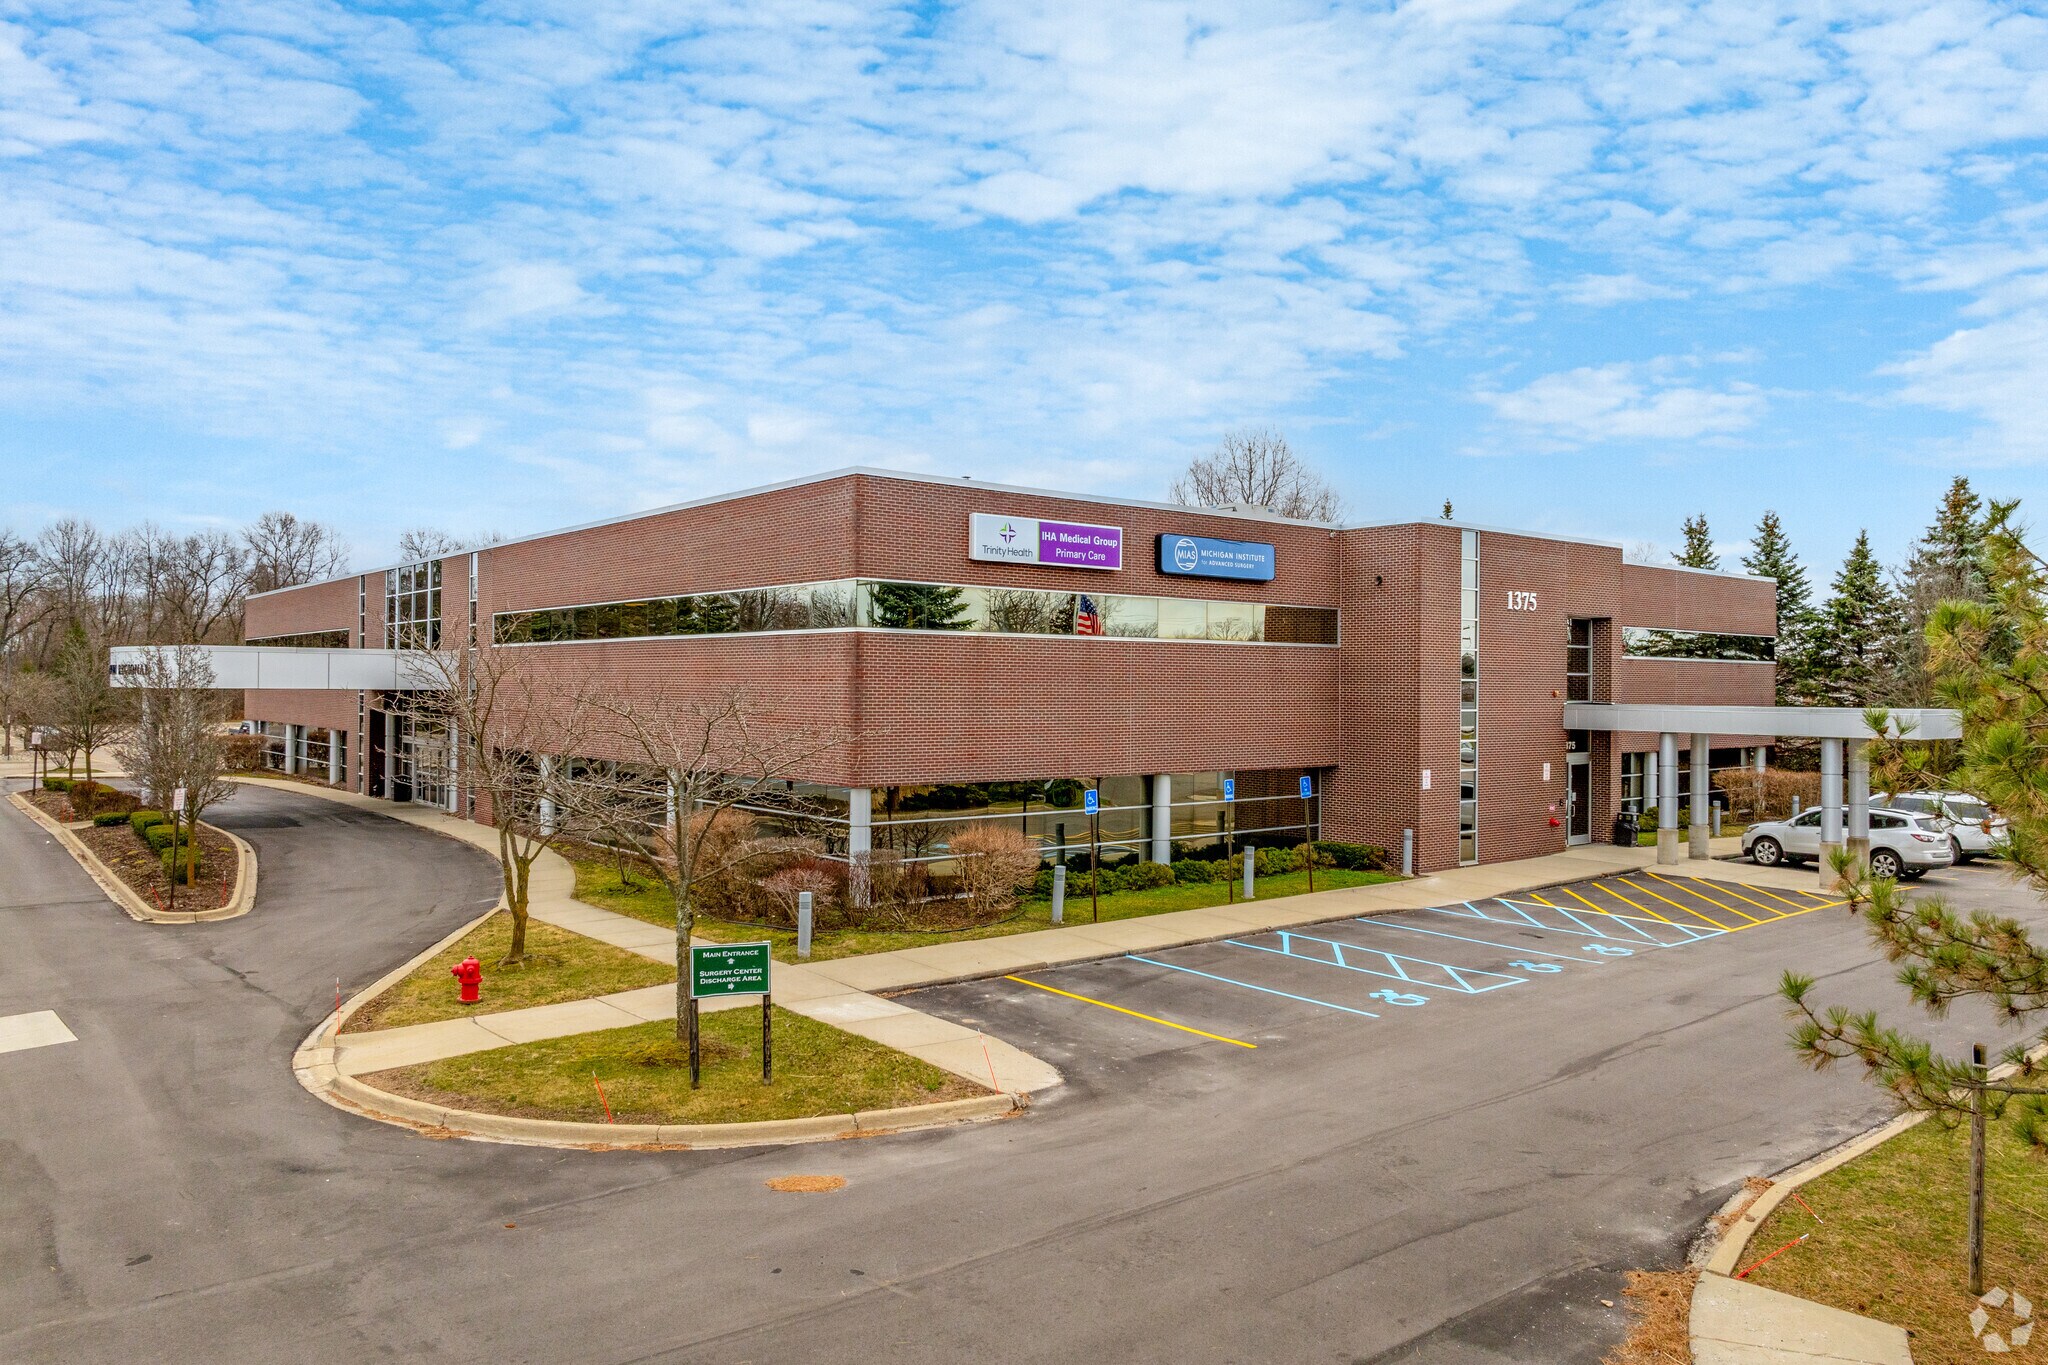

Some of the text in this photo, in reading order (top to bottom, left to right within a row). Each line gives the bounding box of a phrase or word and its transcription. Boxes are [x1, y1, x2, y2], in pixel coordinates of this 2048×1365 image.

[1042, 531, 1118, 548] IHA Medical Group
[982, 545, 1033, 557] Trinity Health
[1056, 548, 1106, 561] Primary Care
[1177, 549, 1196, 560] MIAS
[1201, 550, 1265, 562] MICHIGAN INSTITUTE
[1507, 591, 1537, 611] 1375
[722, 949, 759, 957] ENTRANCE
[700, 976, 740, 985] DISCHARGE
